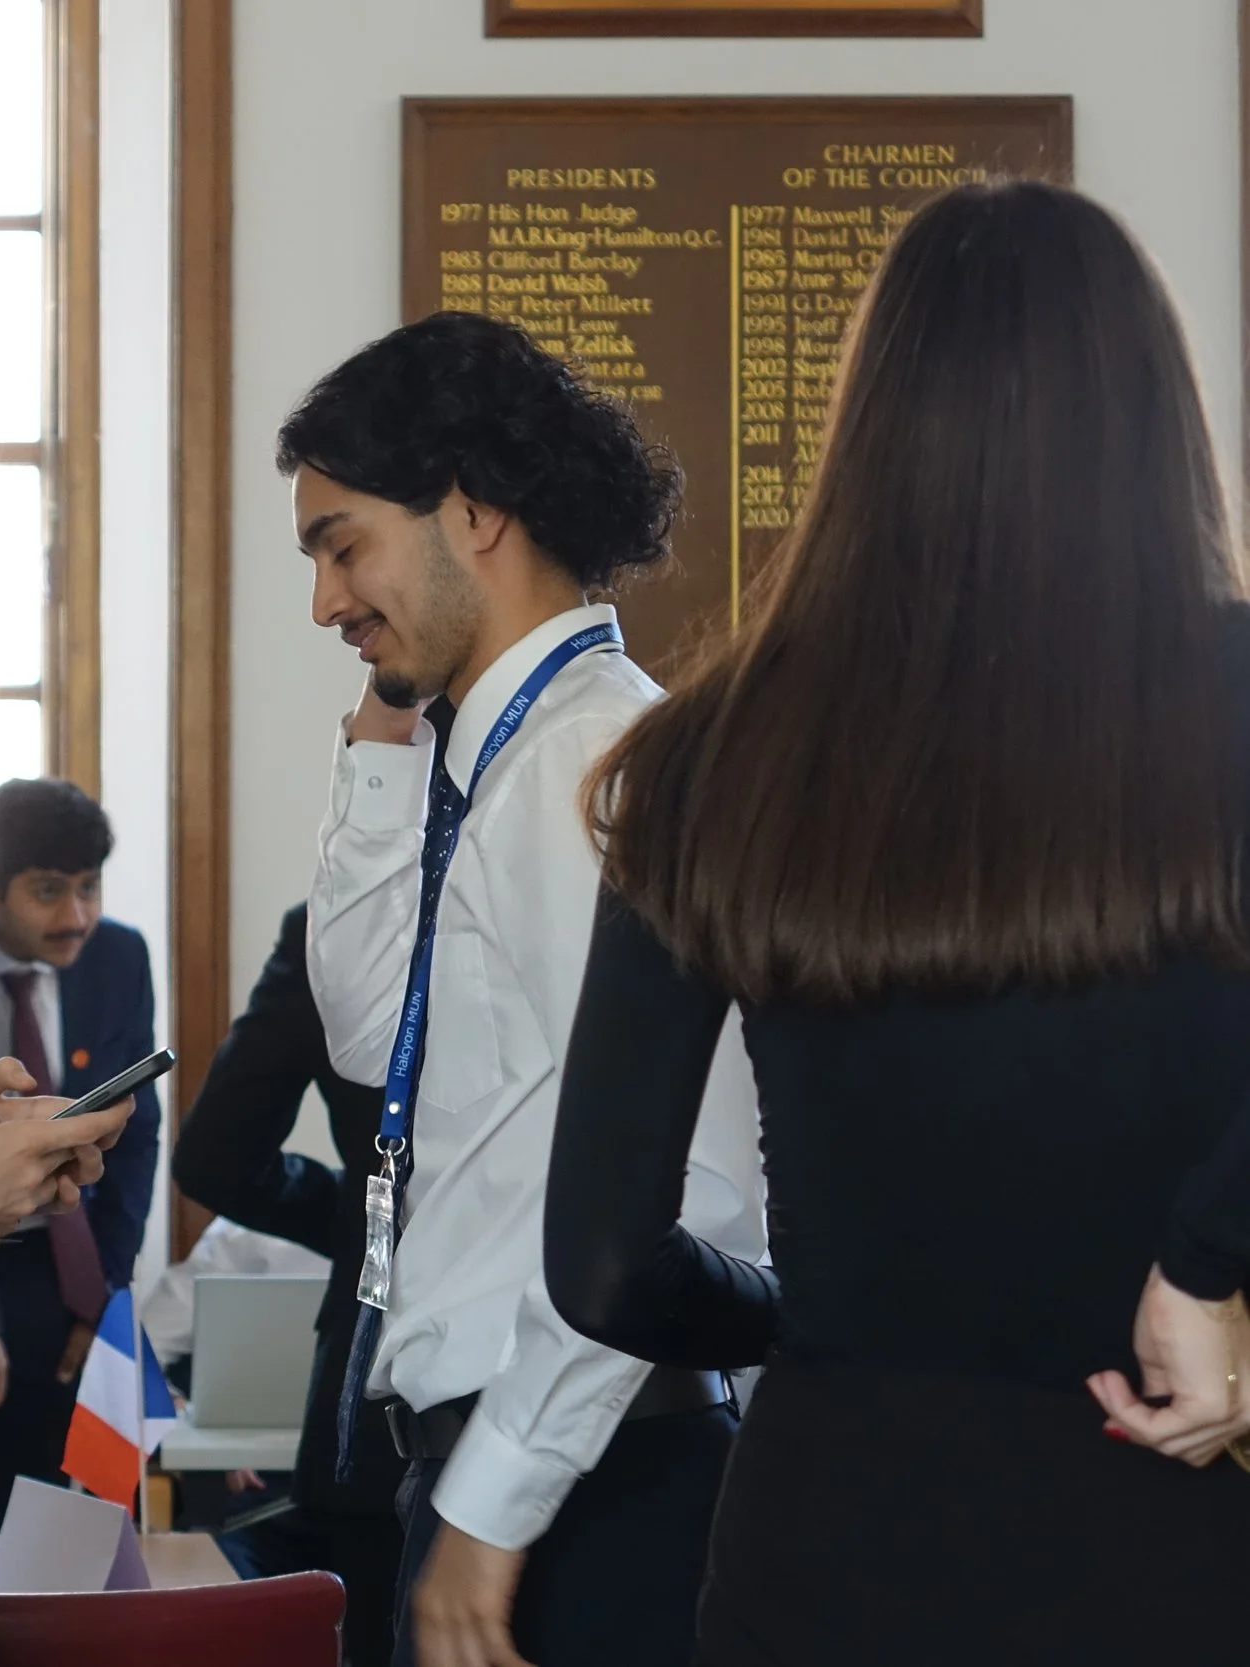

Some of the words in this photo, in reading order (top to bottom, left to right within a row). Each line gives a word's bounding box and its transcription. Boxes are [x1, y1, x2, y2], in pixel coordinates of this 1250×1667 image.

[823, 144, 956, 164] CHAIRMEN
[507, 168, 657, 188] PRESIDENTS
[782, 168, 816, 188] OF
[825, 168, 871, 188] THE
[441, 204, 482, 221] 1977
[488, 203, 520, 221] His
[526, 203, 570, 221] Hon
[577, 202, 638, 225] Judge
[743, 206, 786, 224] 1977
[793, 206, 871, 224] Maxwell
[743, 228, 781, 246] 1981
[794, 228, 849, 246] David
[487, 251, 562, 270] Clifford
[568, 251, 643, 277] Barclay
[794, 250, 852, 268] Martin
[487, 274, 546, 292] David
[551, 274, 608, 293] Walsh
[793, 270, 835, 289] Anne
[488, 296, 514, 313] Sir
[521, 296, 576, 313] Peter
[579, 294, 653, 313] Millett
[743, 294, 786, 312] 1991
[743, 316, 786, 334] 1995
[571, 335, 635, 354] Zellick
[742, 358, 786, 377] 2002
[742, 423, 779, 443] 2011
[742, 465, 780, 483] 2014
[742, 485, 784, 504] 2017
[743, 507, 789, 527] 2020
[570, 627, 607, 650] Halcyon
[476, 728, 511, 771] Halcyon
[503, 694, 530, 726] MUN
[394, 1026, 415, 1077] Halcyon
[406, 991, 422, 1023] MUN
